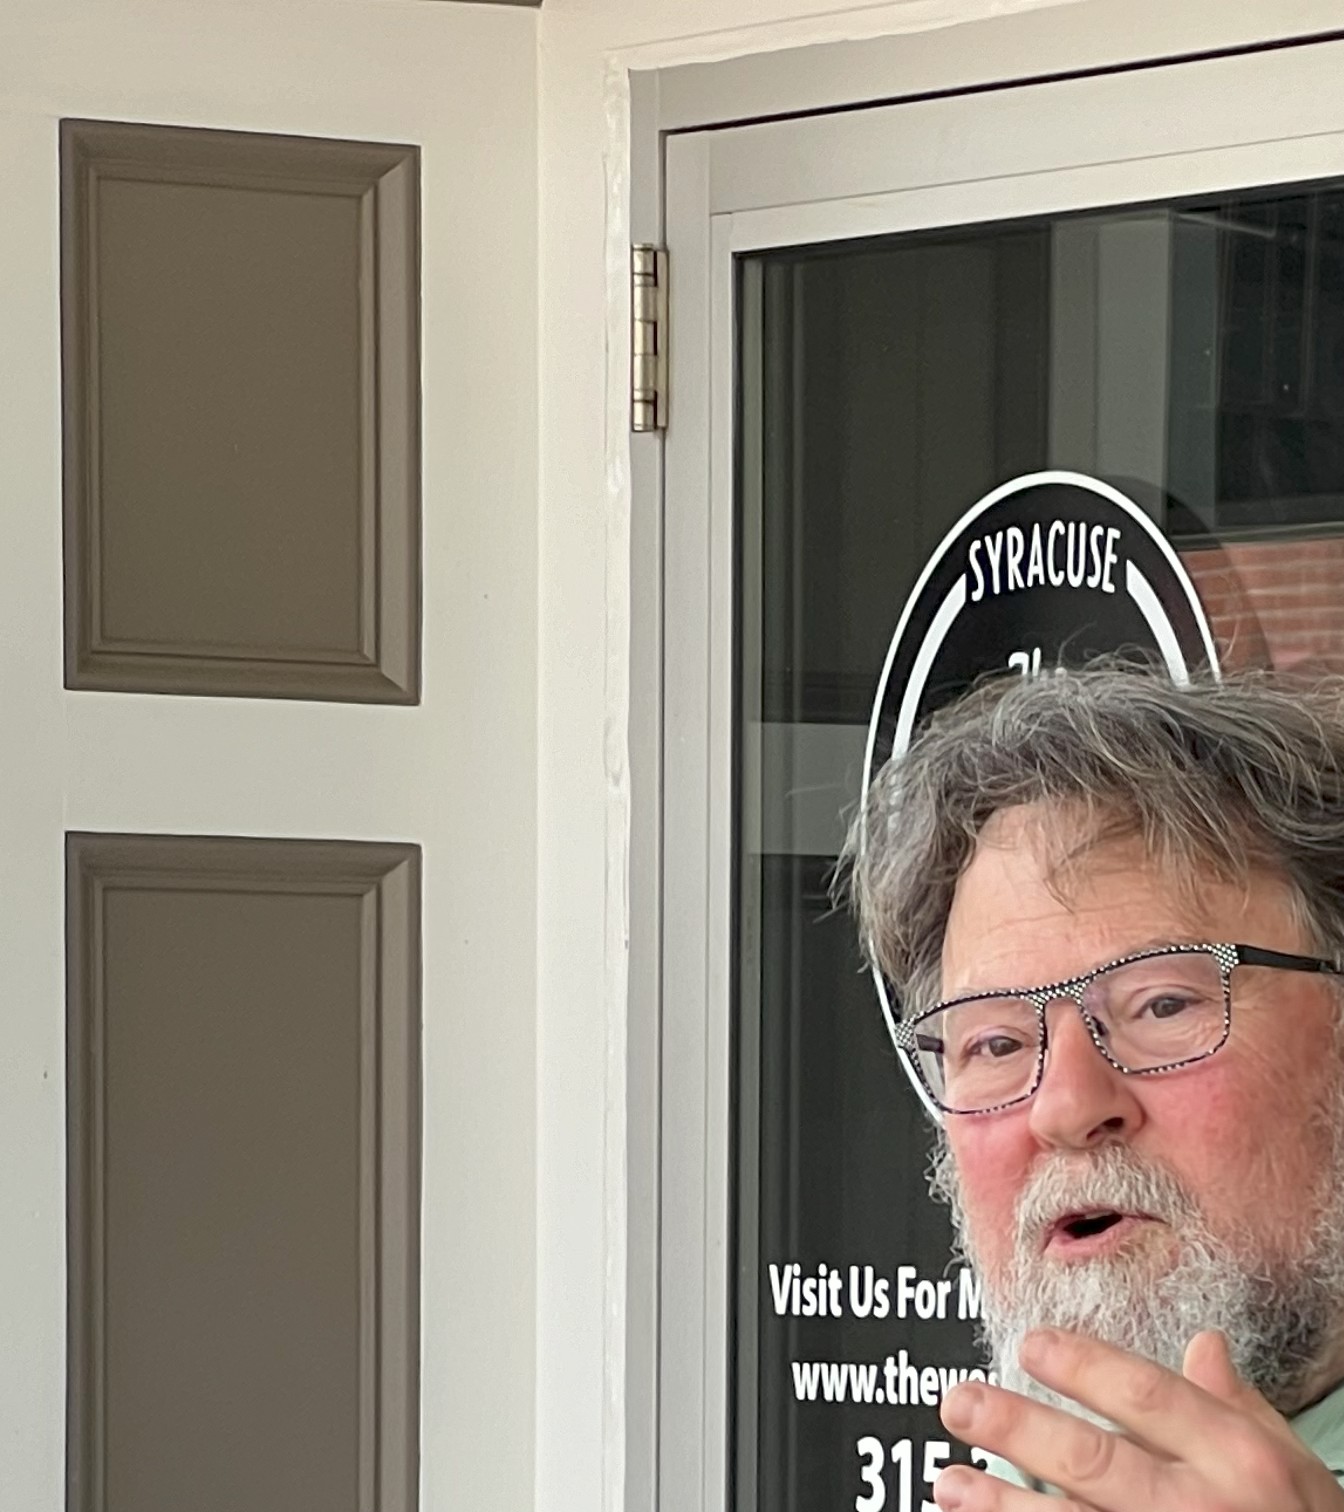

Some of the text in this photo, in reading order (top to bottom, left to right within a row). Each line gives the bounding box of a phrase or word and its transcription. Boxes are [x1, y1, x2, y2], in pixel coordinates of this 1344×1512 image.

[967, 519, 1121, 602] SYRACUSE
[769, 1263, 843, 1317] Visit
[850, 1265, 890, 1318] Us
[897, 1266, 951, 1319] For
